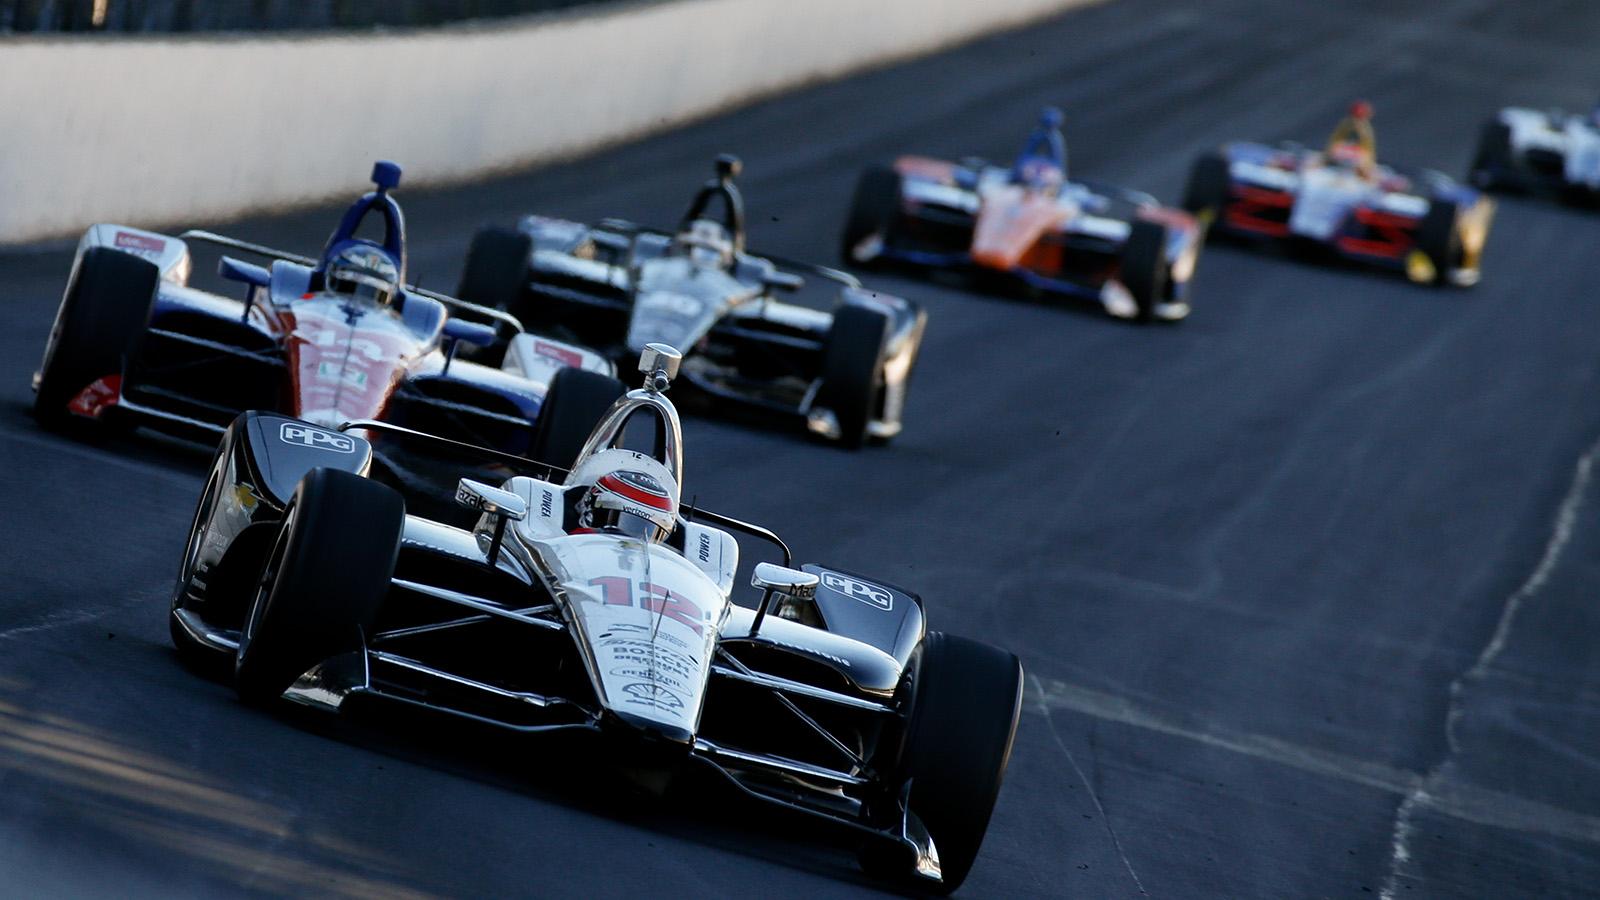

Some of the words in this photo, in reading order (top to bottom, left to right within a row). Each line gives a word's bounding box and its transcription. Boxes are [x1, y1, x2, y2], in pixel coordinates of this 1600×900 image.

[284, 427, 350, 450] PPG
[632, 452, 643, 460] 12
[541, 489, 553, 518] POWER
[622, 505, 652, 520] verizon
[698, 533, 711, 562] POWER
[825, 575, 889, 607] PPG
[587, 575, 704, 640] 12
